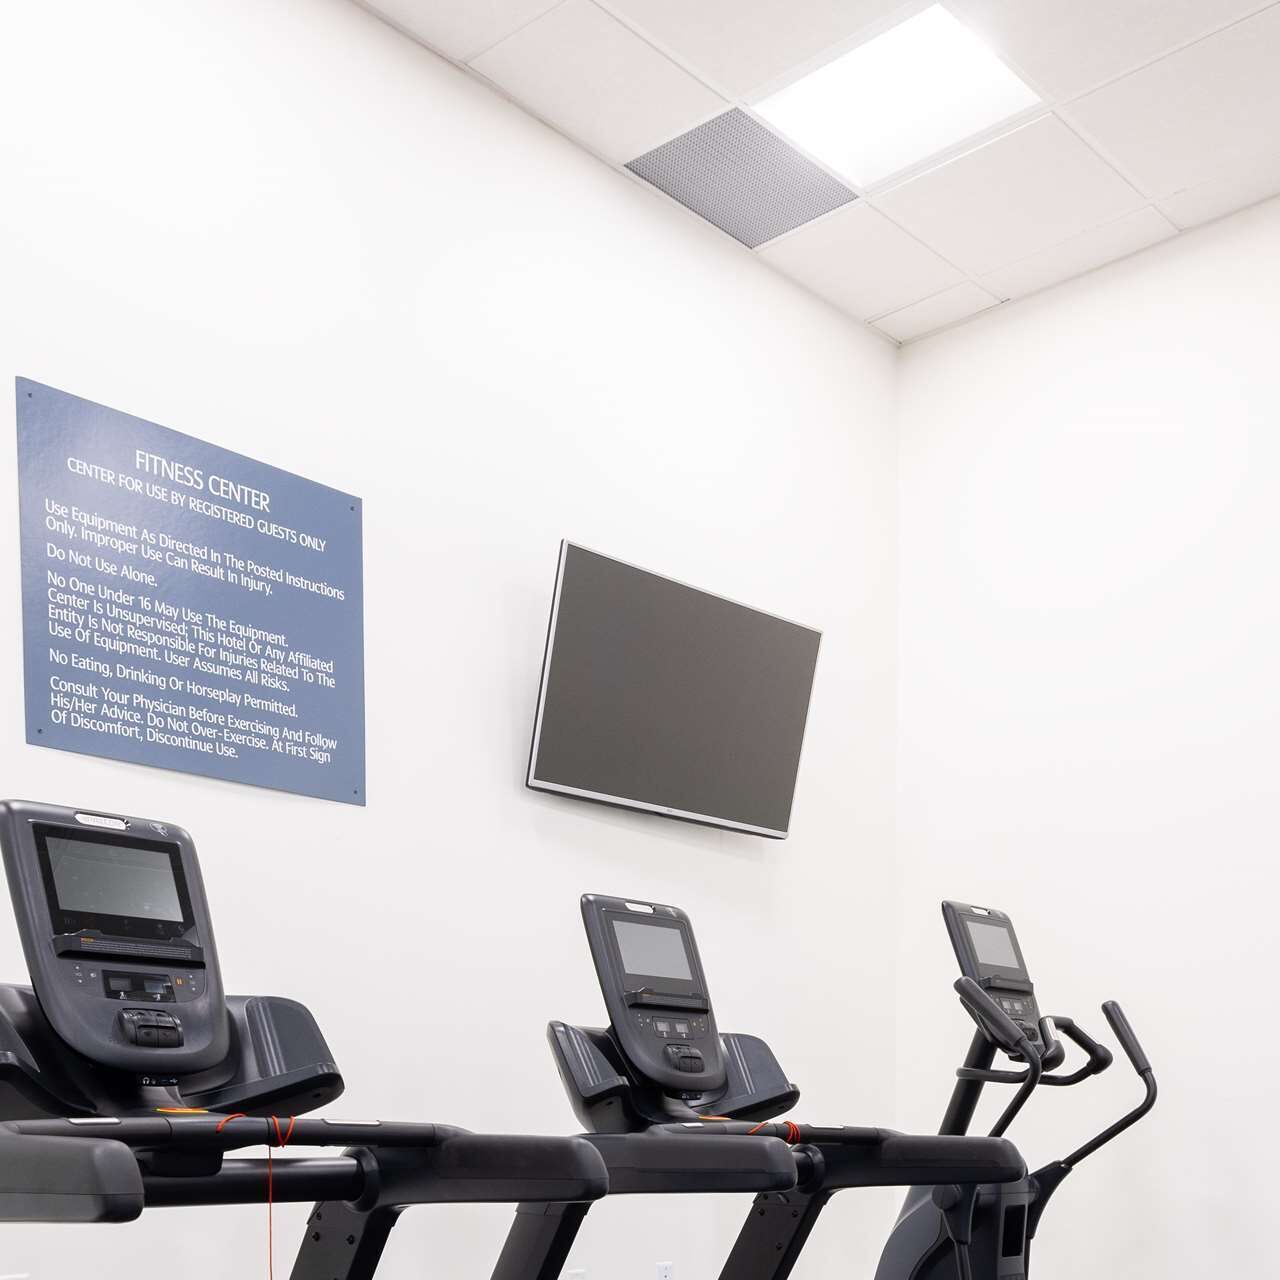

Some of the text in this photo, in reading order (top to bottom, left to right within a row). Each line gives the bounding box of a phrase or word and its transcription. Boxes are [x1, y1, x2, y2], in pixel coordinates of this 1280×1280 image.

[67, 457, 326, 552] CENTER FOR USE BY REGISTERED GUESTS ONLY
[135, 449, 271, 512] FITNESS CENTER
[45, 498, 345, 600] Use Equipment As Directed In The Posted Instructions
[45, 515, 273, 596] Only. Improper Use Can Result In Injury.
[46, 542, 158, 586] Do Not Use Alone.
[47, 569, 289, 647] No One Under 16 May Use The Equipment.
[47, 587, 334, 673] Center Is Unsupervised; This Hotel Or Any Affiliated
[48, 603, 336, 688] Entity Is Not Responsible For Injuries Related To The
[48, 620, 290, 691] Use Of Equipment. User Assumes All Risks.
[49, 647, 298, 717] No Eating, Drinking Or Horseplay Permitted.
[49, 675, 338, 749] Consult Your Physician Before Exercising And Follow
[50, 691, 331, 763] His/Her Advice. Do Not Over-Exercise. At First Sign
[51, 708, 239, 758] Of Discomfort, Discontinue Use.
